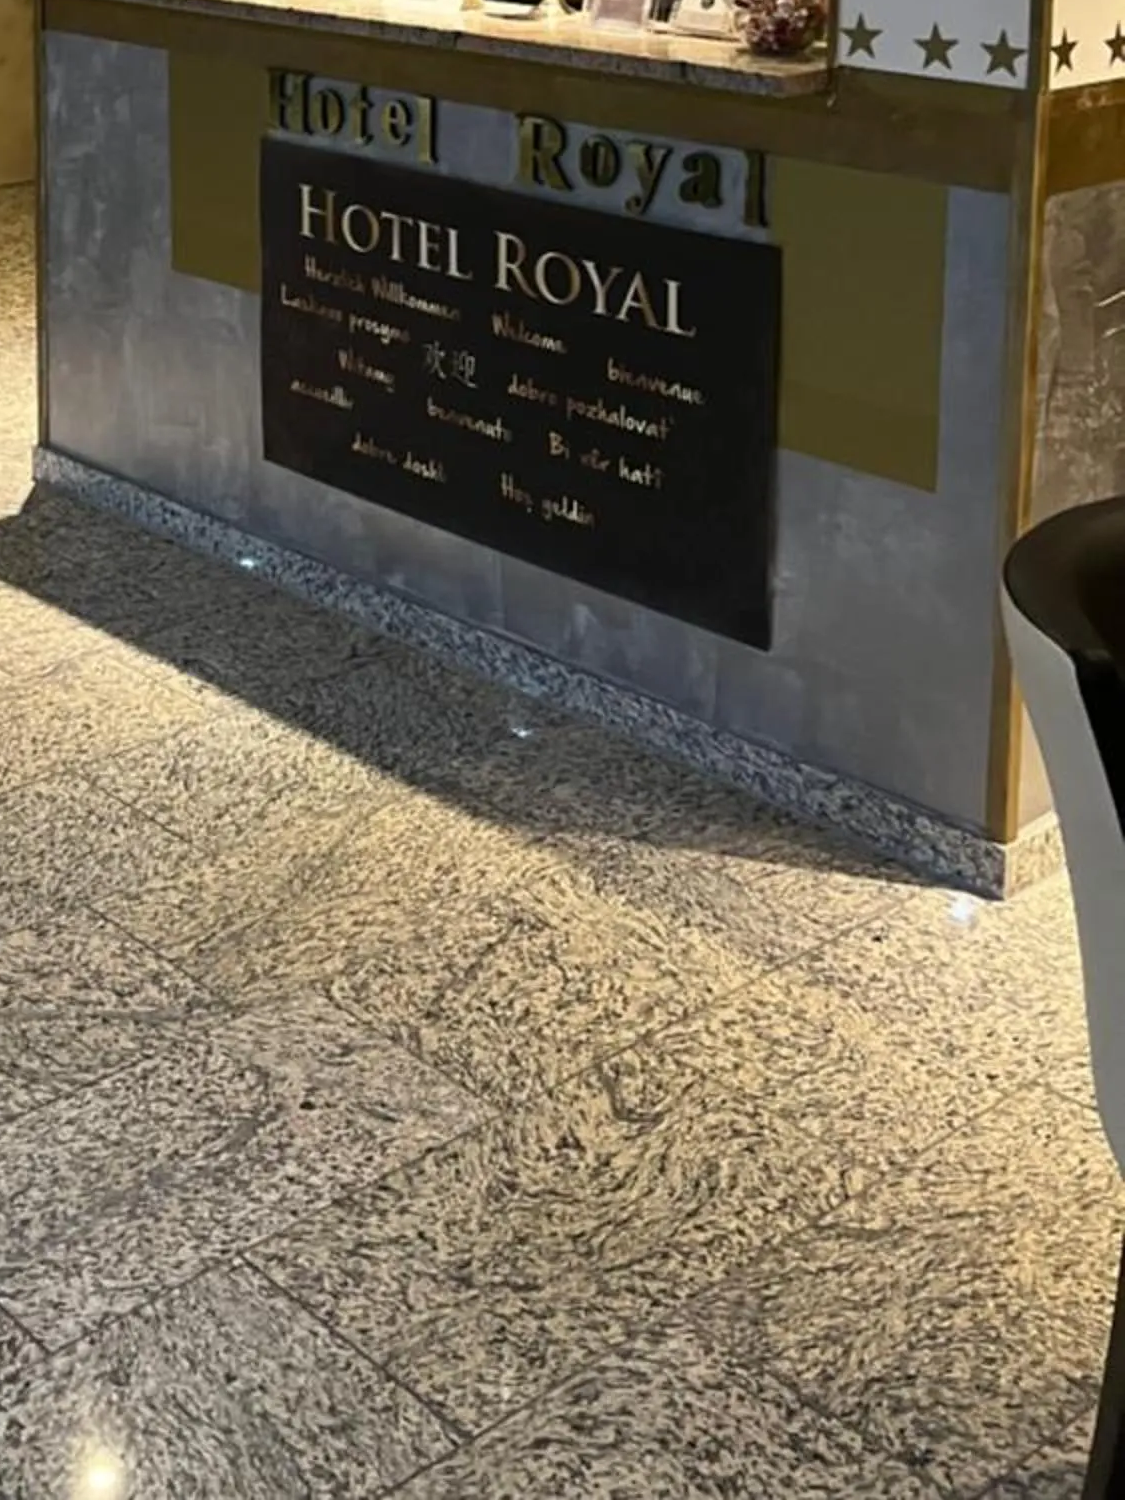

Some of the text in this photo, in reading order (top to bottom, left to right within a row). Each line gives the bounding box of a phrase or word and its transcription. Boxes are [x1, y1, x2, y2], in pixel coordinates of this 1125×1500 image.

[269, 68, 769, 228] Hotel Royal
[298, 183, 697, 338] HOTEL ROYAL
